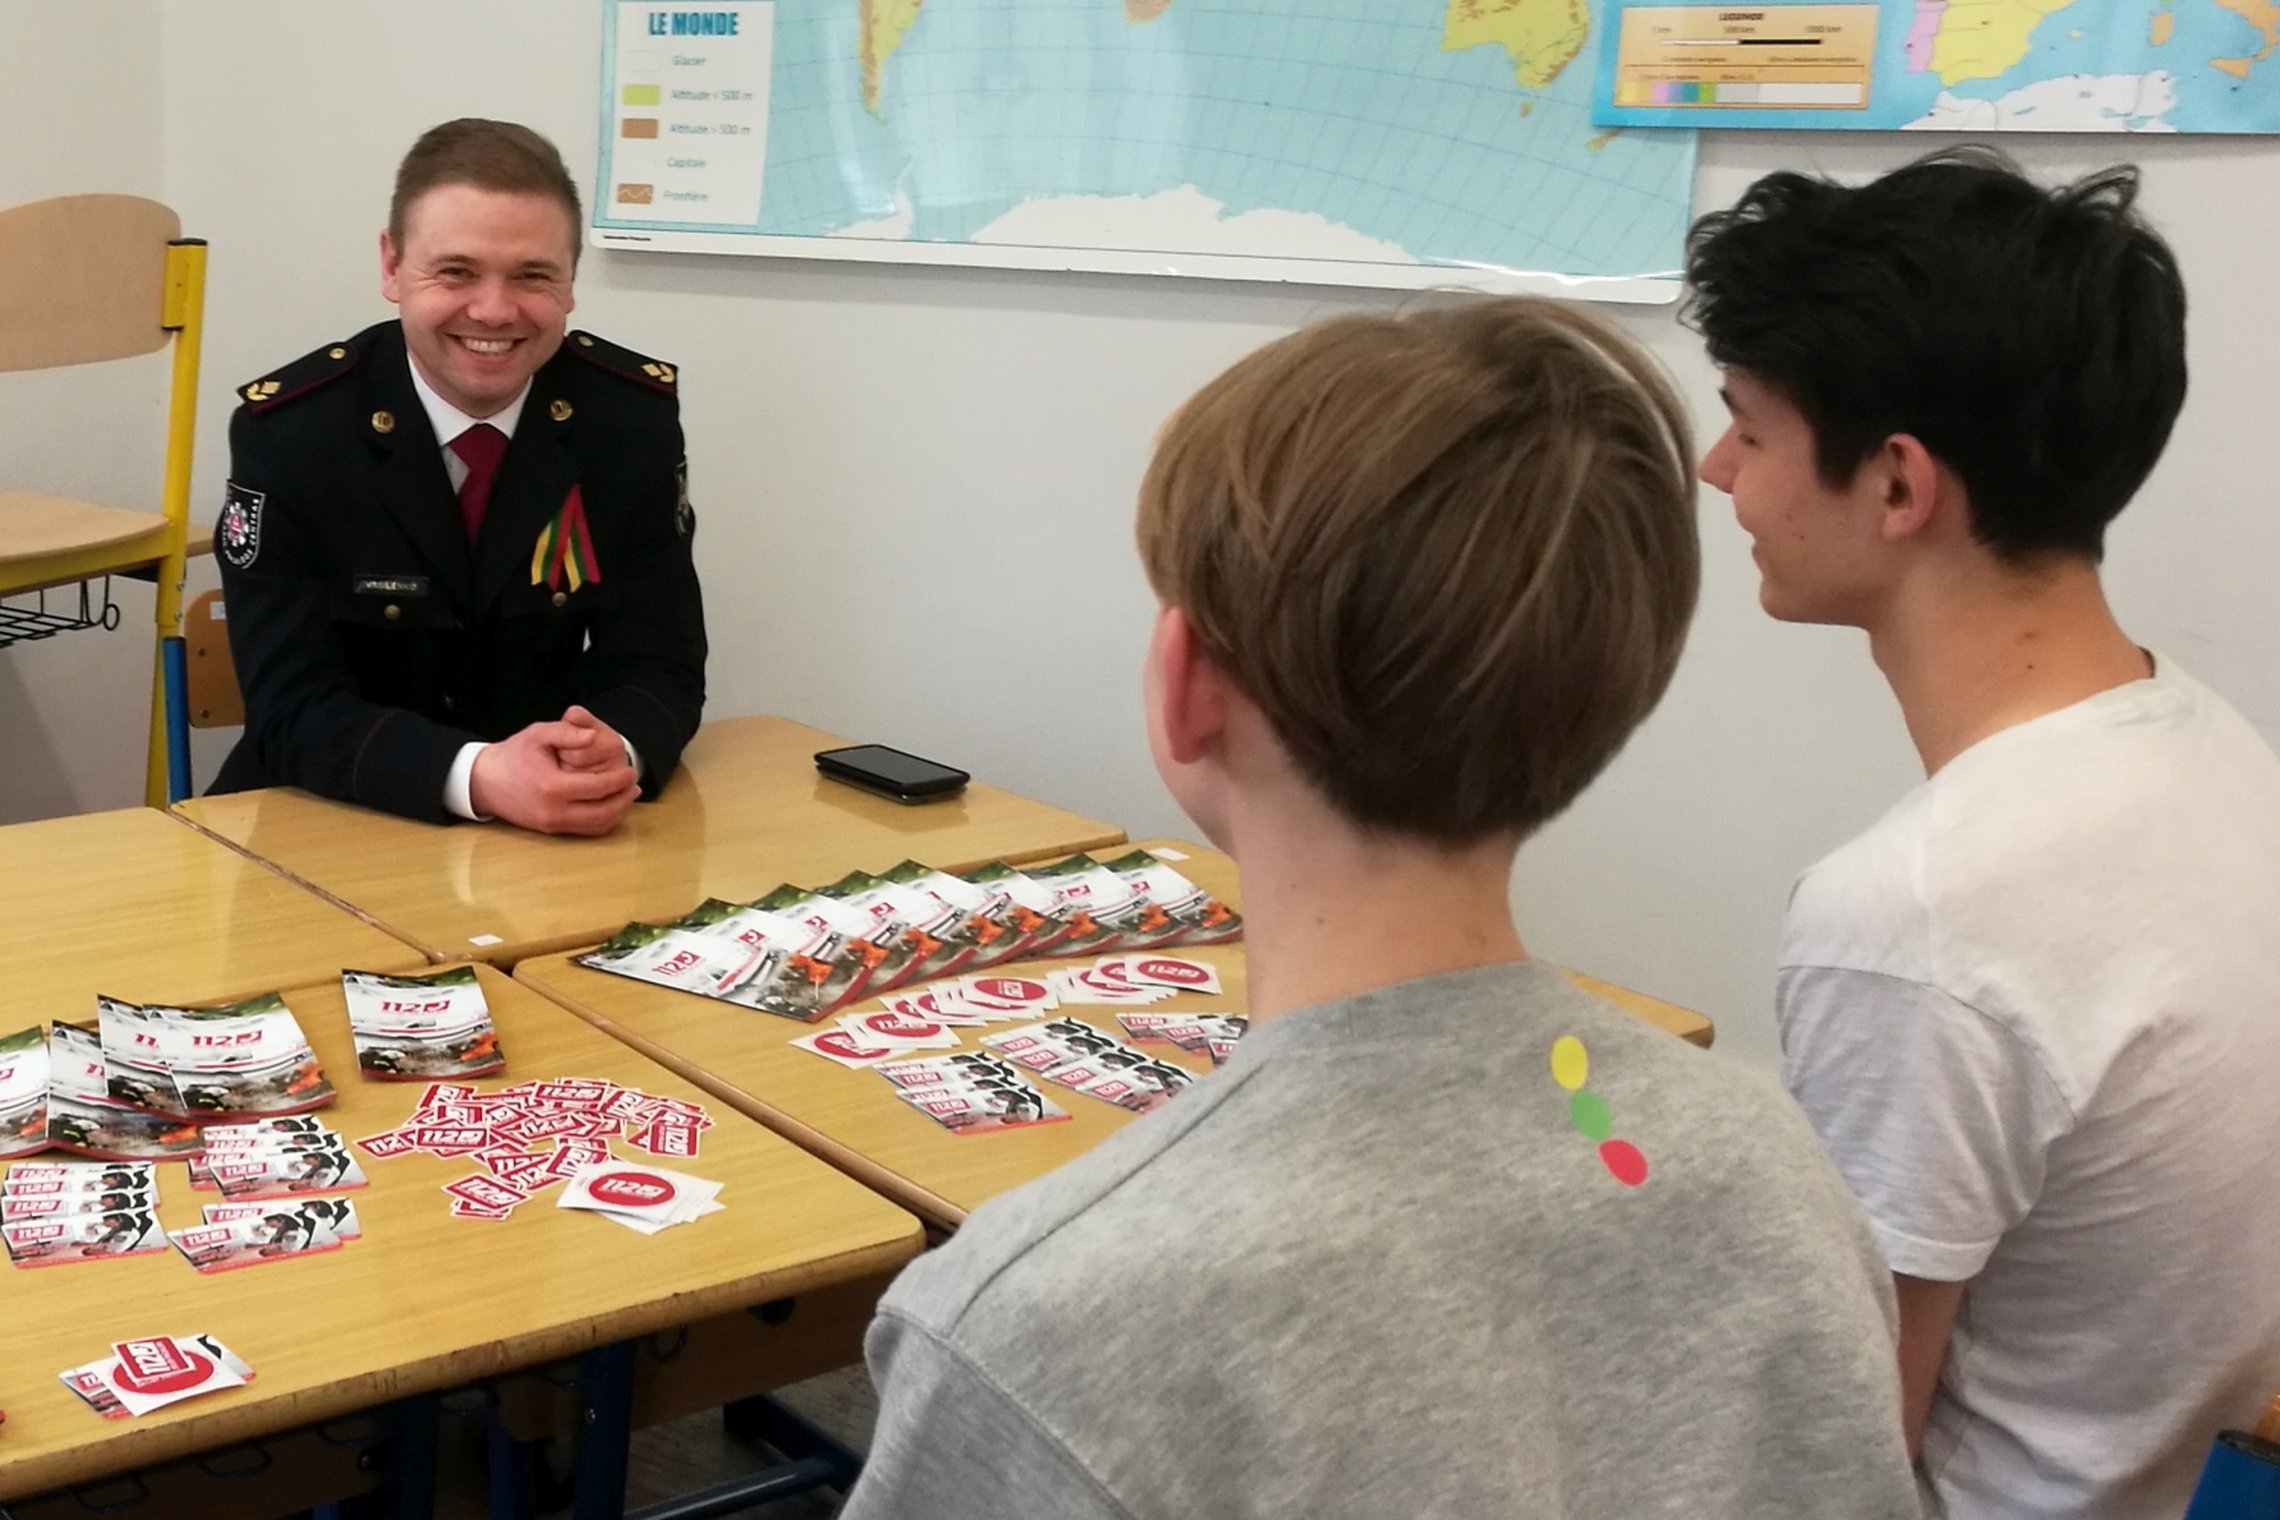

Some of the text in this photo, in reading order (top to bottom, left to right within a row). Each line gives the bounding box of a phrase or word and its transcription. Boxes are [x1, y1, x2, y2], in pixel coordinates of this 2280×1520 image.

[649, 12, 739, 35] LE MONDE
[672, 56, 706, 67] Glacier
[671, 90, 709, 101] Altitude
[669, 124, 708, 135] Altitude
[667, 157, 706, 169] Capitale
